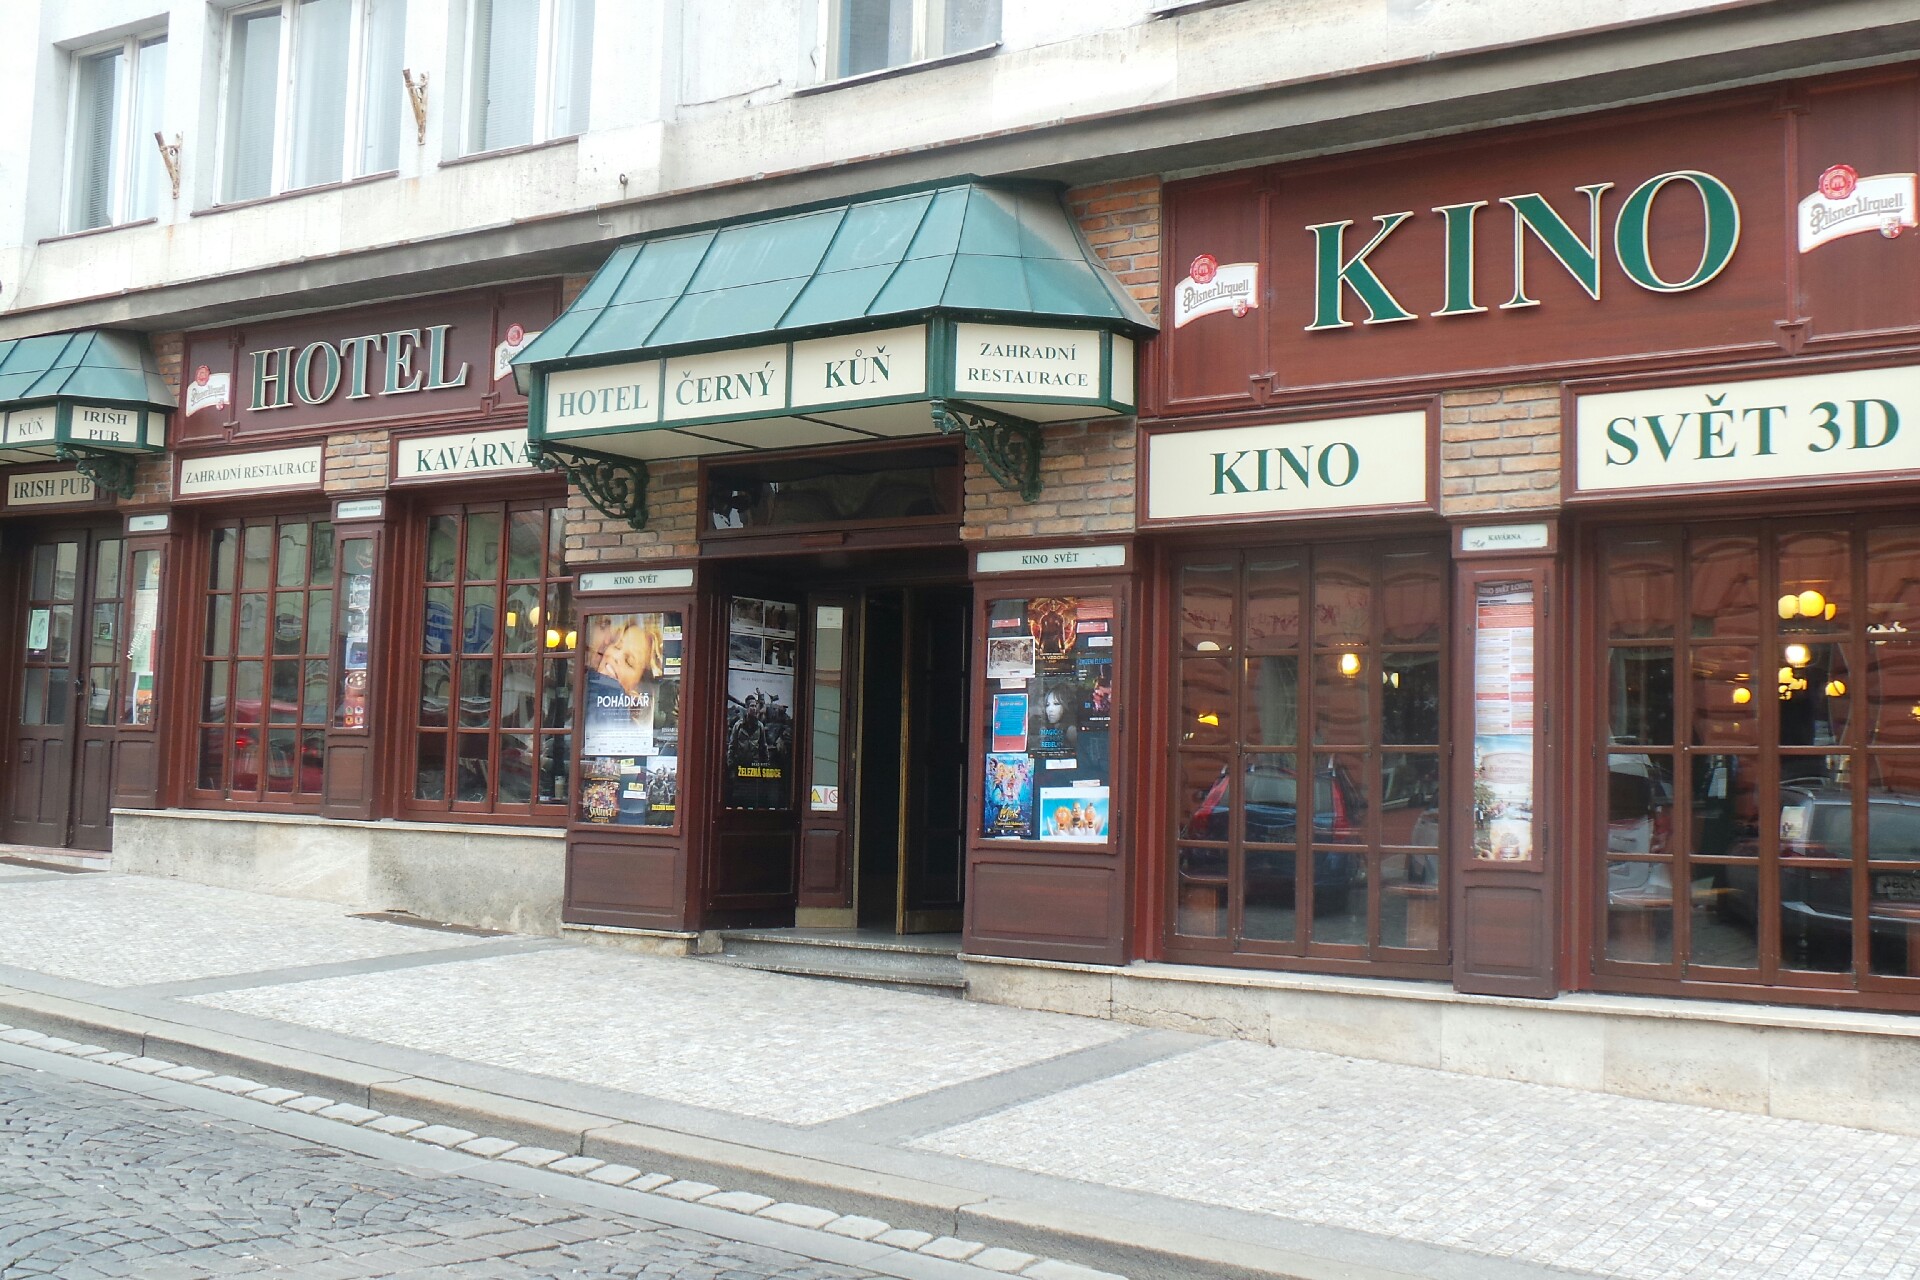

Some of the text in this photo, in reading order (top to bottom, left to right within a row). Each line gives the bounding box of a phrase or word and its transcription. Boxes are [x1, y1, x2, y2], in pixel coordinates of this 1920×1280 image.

[1810, 193, 1903, 235] Pilsner Urquell
[1304, 169, 1741, 331] KINO
[1183, 279, 1249, 313] Pilsner Urquell
[979, 342, 1076, 361] ZAHRADNÍ
[246, 324, 469, 411] HOTEL
[967, 367, 1088, 387] RESTAURACE
[558, 344, 890, 417] HOTEL ČERNÝ KŮŇ
[18, 416, 44, 437] KŮŇ
[83, 410, 127, 425] IRISH
[89, 429, 120, 442] PUB
[1605, 393, 1900, 466] SVĚT 3D
[416, 437, 533, 472] KAVÁRNA
[185, 460, 318, 484] ZAHRADNÍ RESTAURACE
[1209, 442, 1360, 496] KINO
[13, 477, 92, 499] IRISH PUB
[1488, 533, 1521, 541] KAVÁRNA
[1021, 552, 1079, 564] KINO SVĚT
[613, 574, 658, 585] KINO SVĚT
[597, 692, 650, 708] POHÁDKÁŘ
